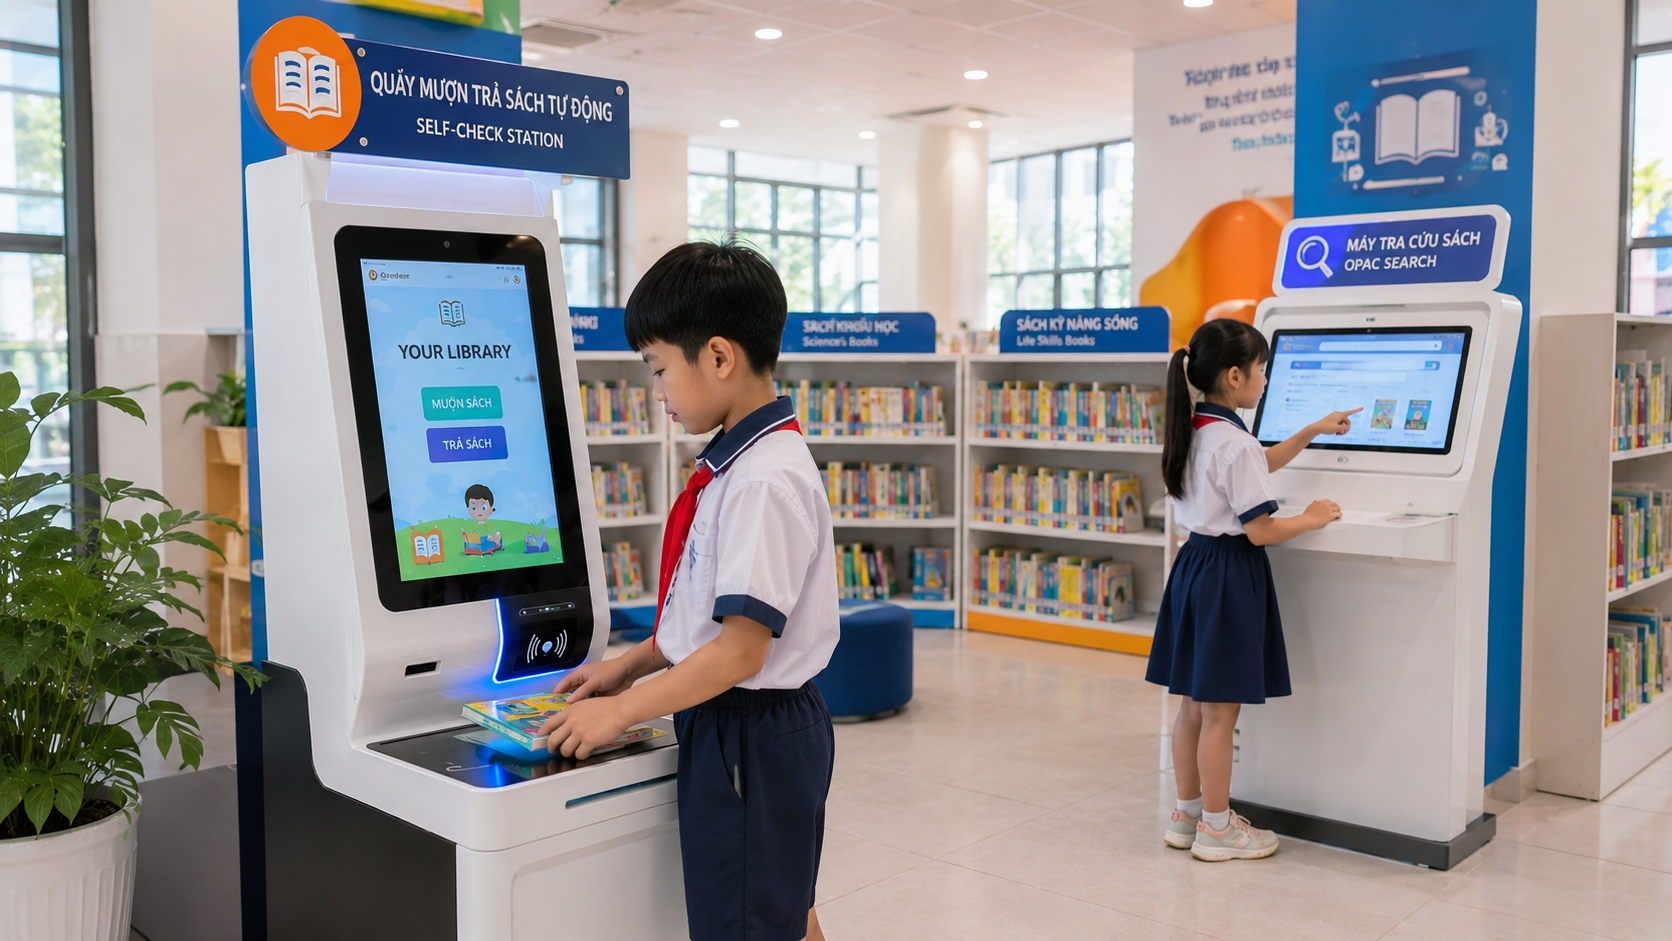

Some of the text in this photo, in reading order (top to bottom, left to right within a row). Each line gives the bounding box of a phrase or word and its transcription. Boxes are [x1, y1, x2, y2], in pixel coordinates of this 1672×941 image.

[419, 76, 469, 107] MƯỢN
[471, 81, 503, 108] TRẢ
[505, 85, 545, 114] SÁCH
[547, 94, 569, 121] TỰ
[570, 94, 613, 124] ĐỘNG
[416, 117, 564, 149] SELF-CHECK STATION
[1346, 228, 1481, 252] MÁY TRA CỨU SÁCH
[1344, 254, 1438, 272] OPAC SEARCH
[874, 319, 900, 336] HỌC
[1064, 334, 1096, 347] Books
[398, 344, 512, 360] YOUR LIBRARY
